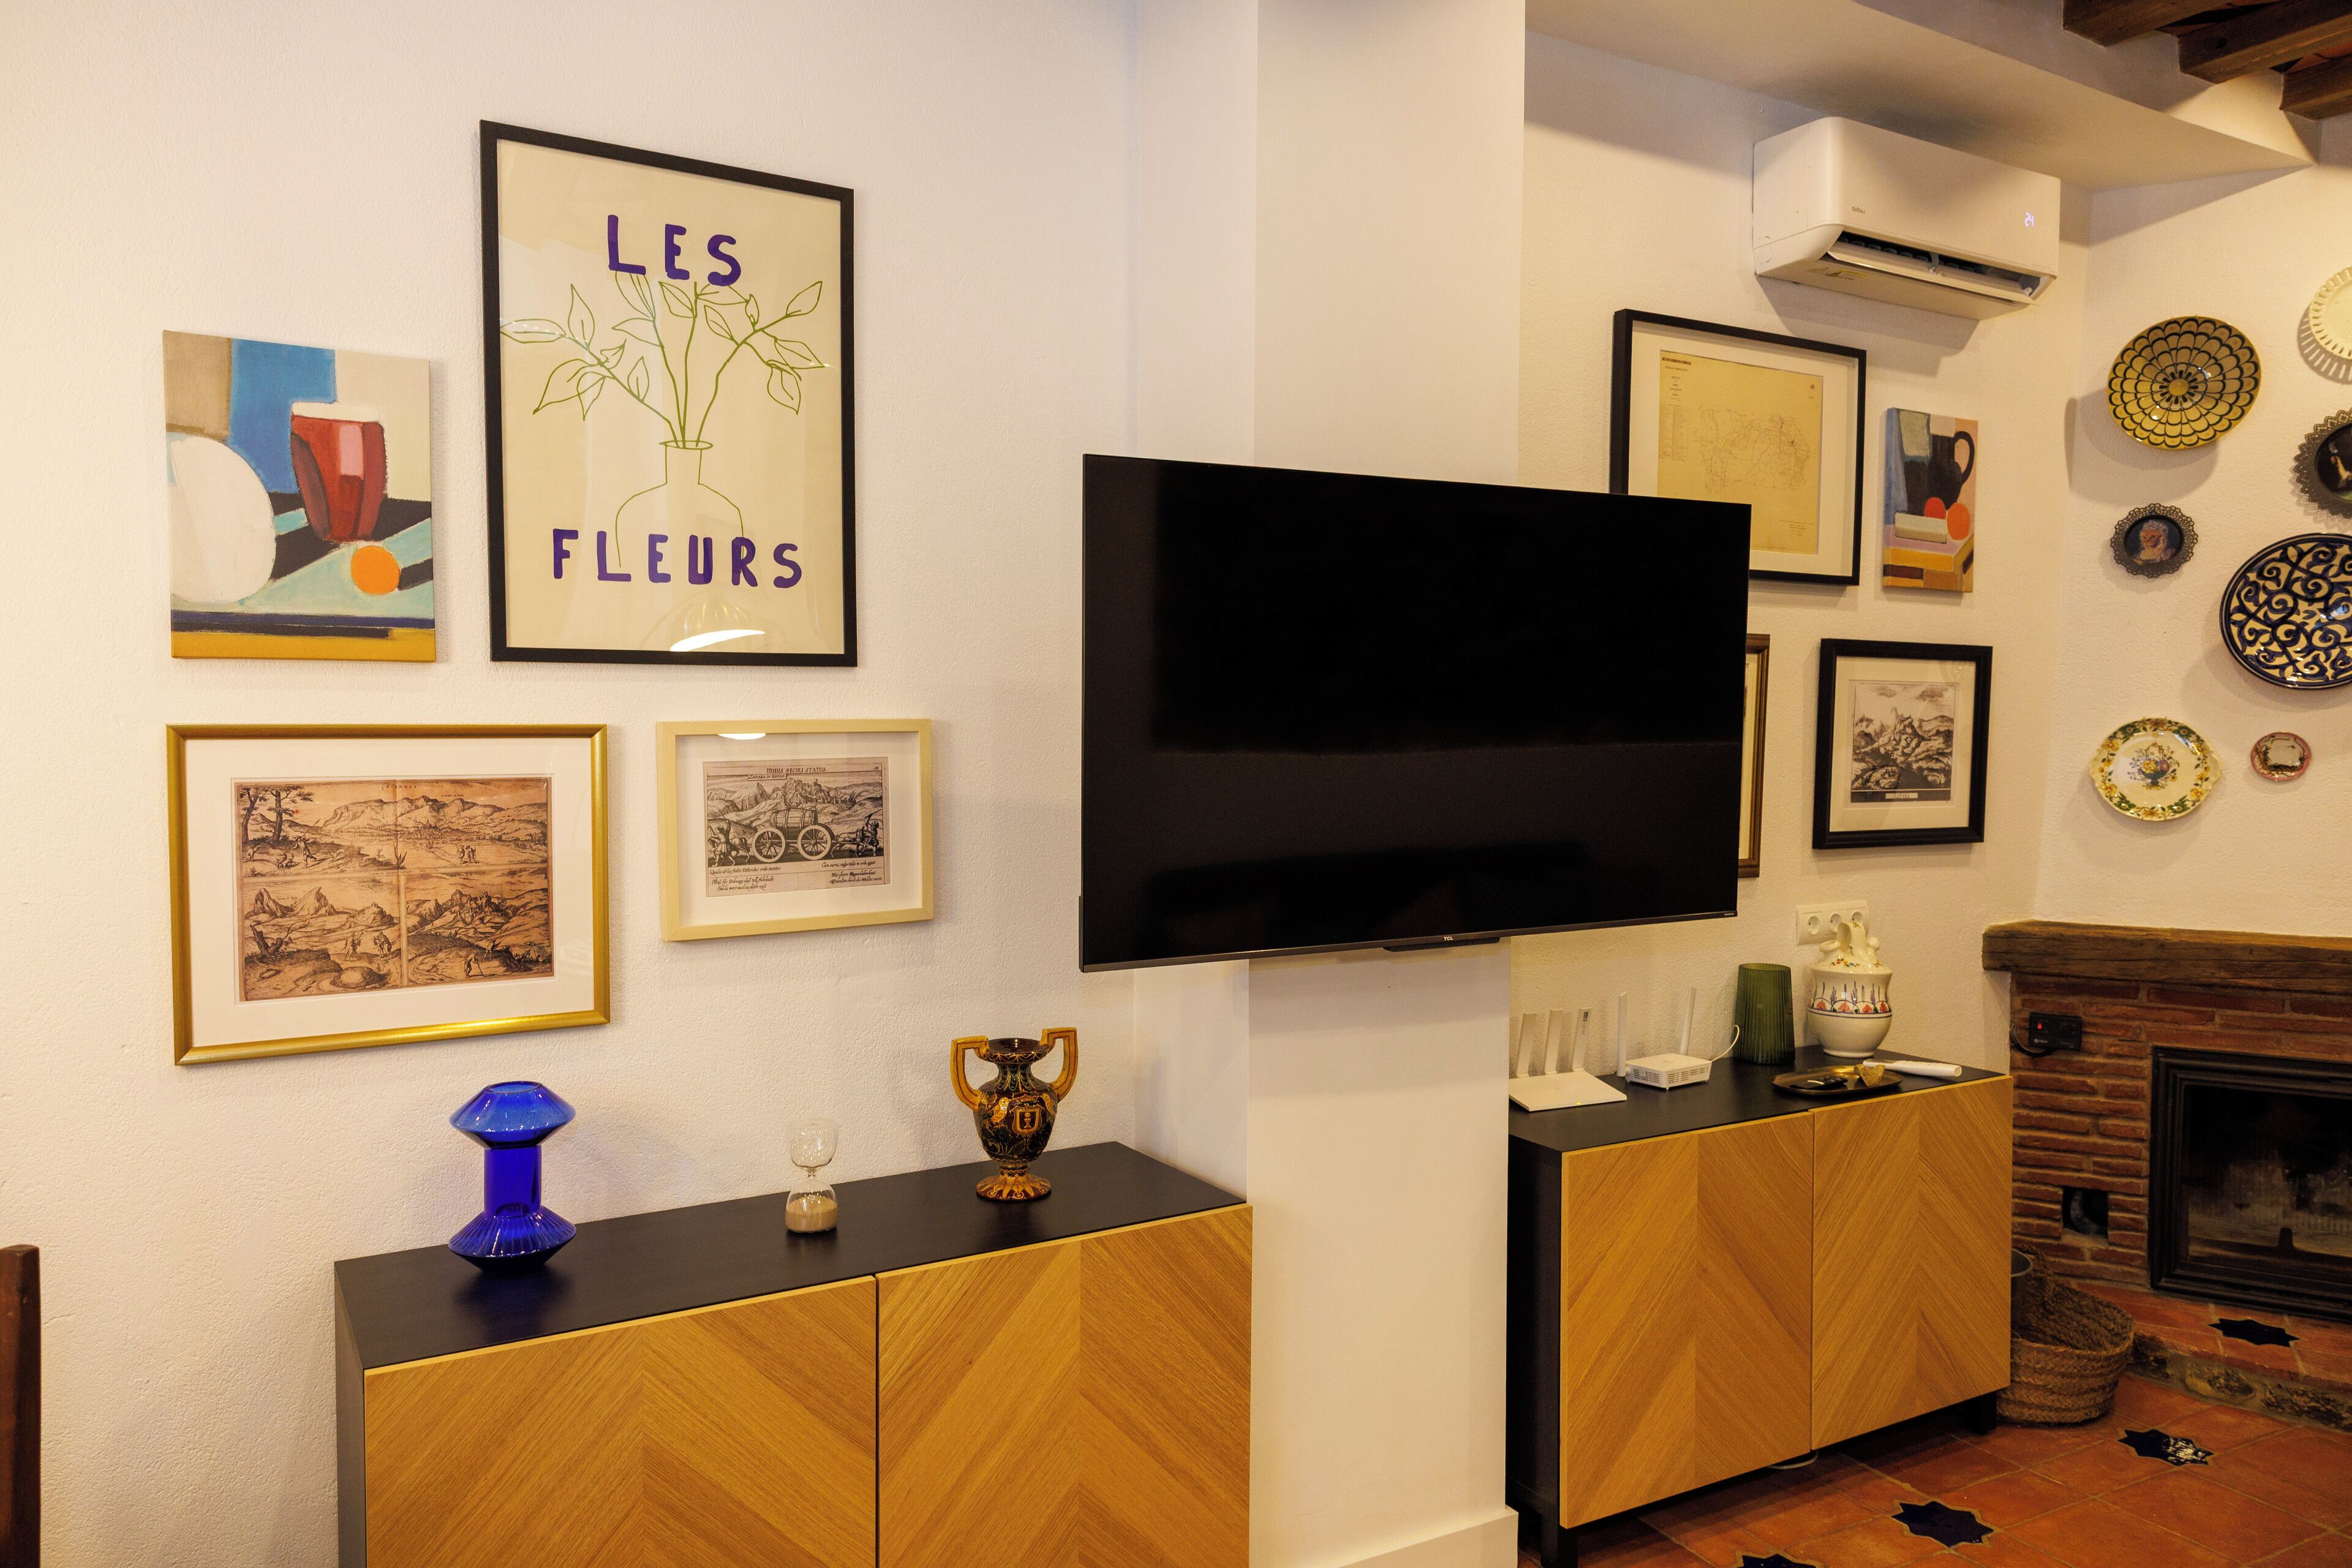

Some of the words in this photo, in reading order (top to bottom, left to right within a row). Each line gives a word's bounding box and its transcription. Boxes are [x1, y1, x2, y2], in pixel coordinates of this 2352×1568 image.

[2024, 212, 2035, 226] 24
[608, 215, 741, 286] LES
[552, 528, 801, 588] FLEURS
